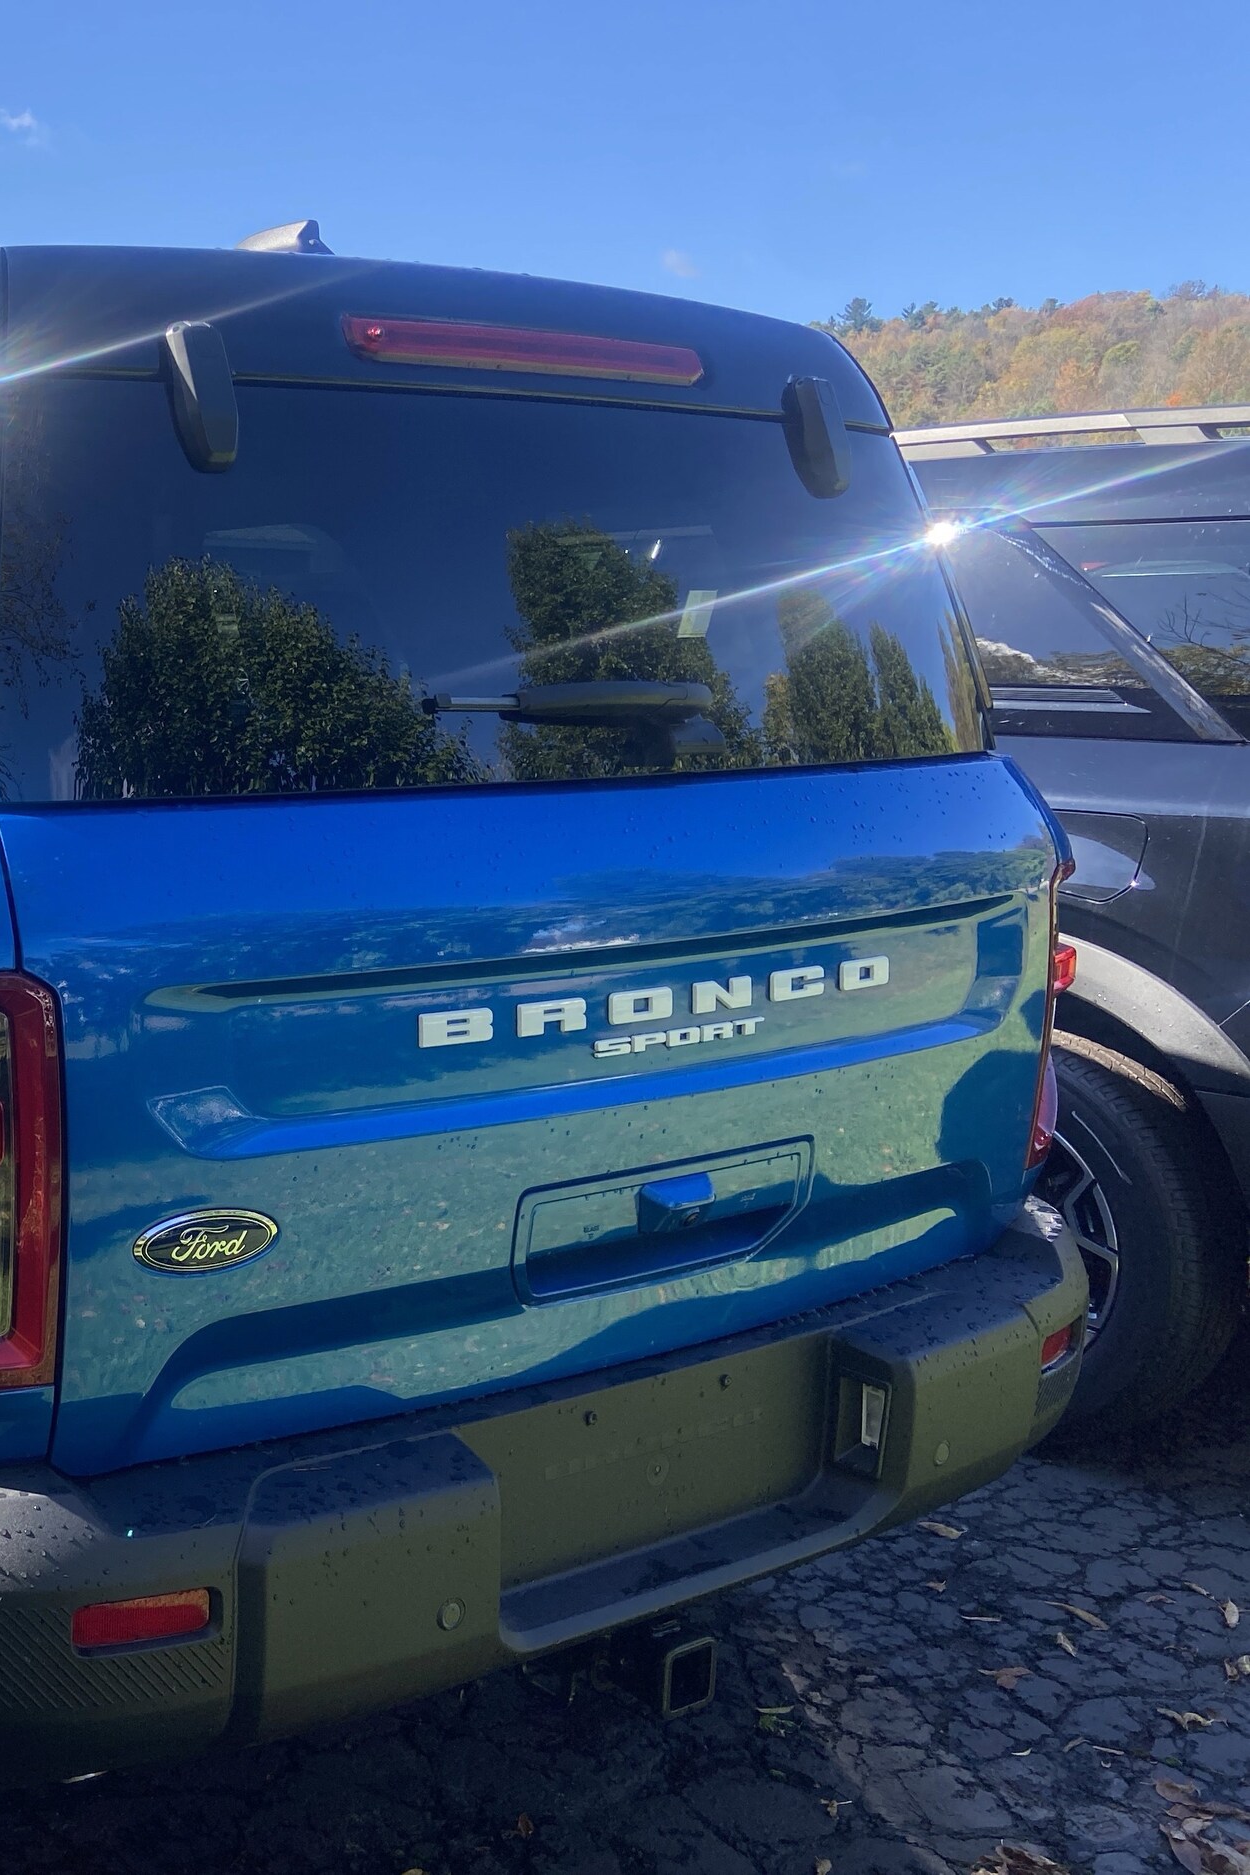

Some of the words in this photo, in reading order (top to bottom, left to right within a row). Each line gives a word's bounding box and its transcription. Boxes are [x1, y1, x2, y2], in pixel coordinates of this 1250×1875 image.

[417, 955, 890, 1049] BRONCO
[593, 1016, 765, 1059] SPORT
[170, 1224, 248, 1263] Ford
